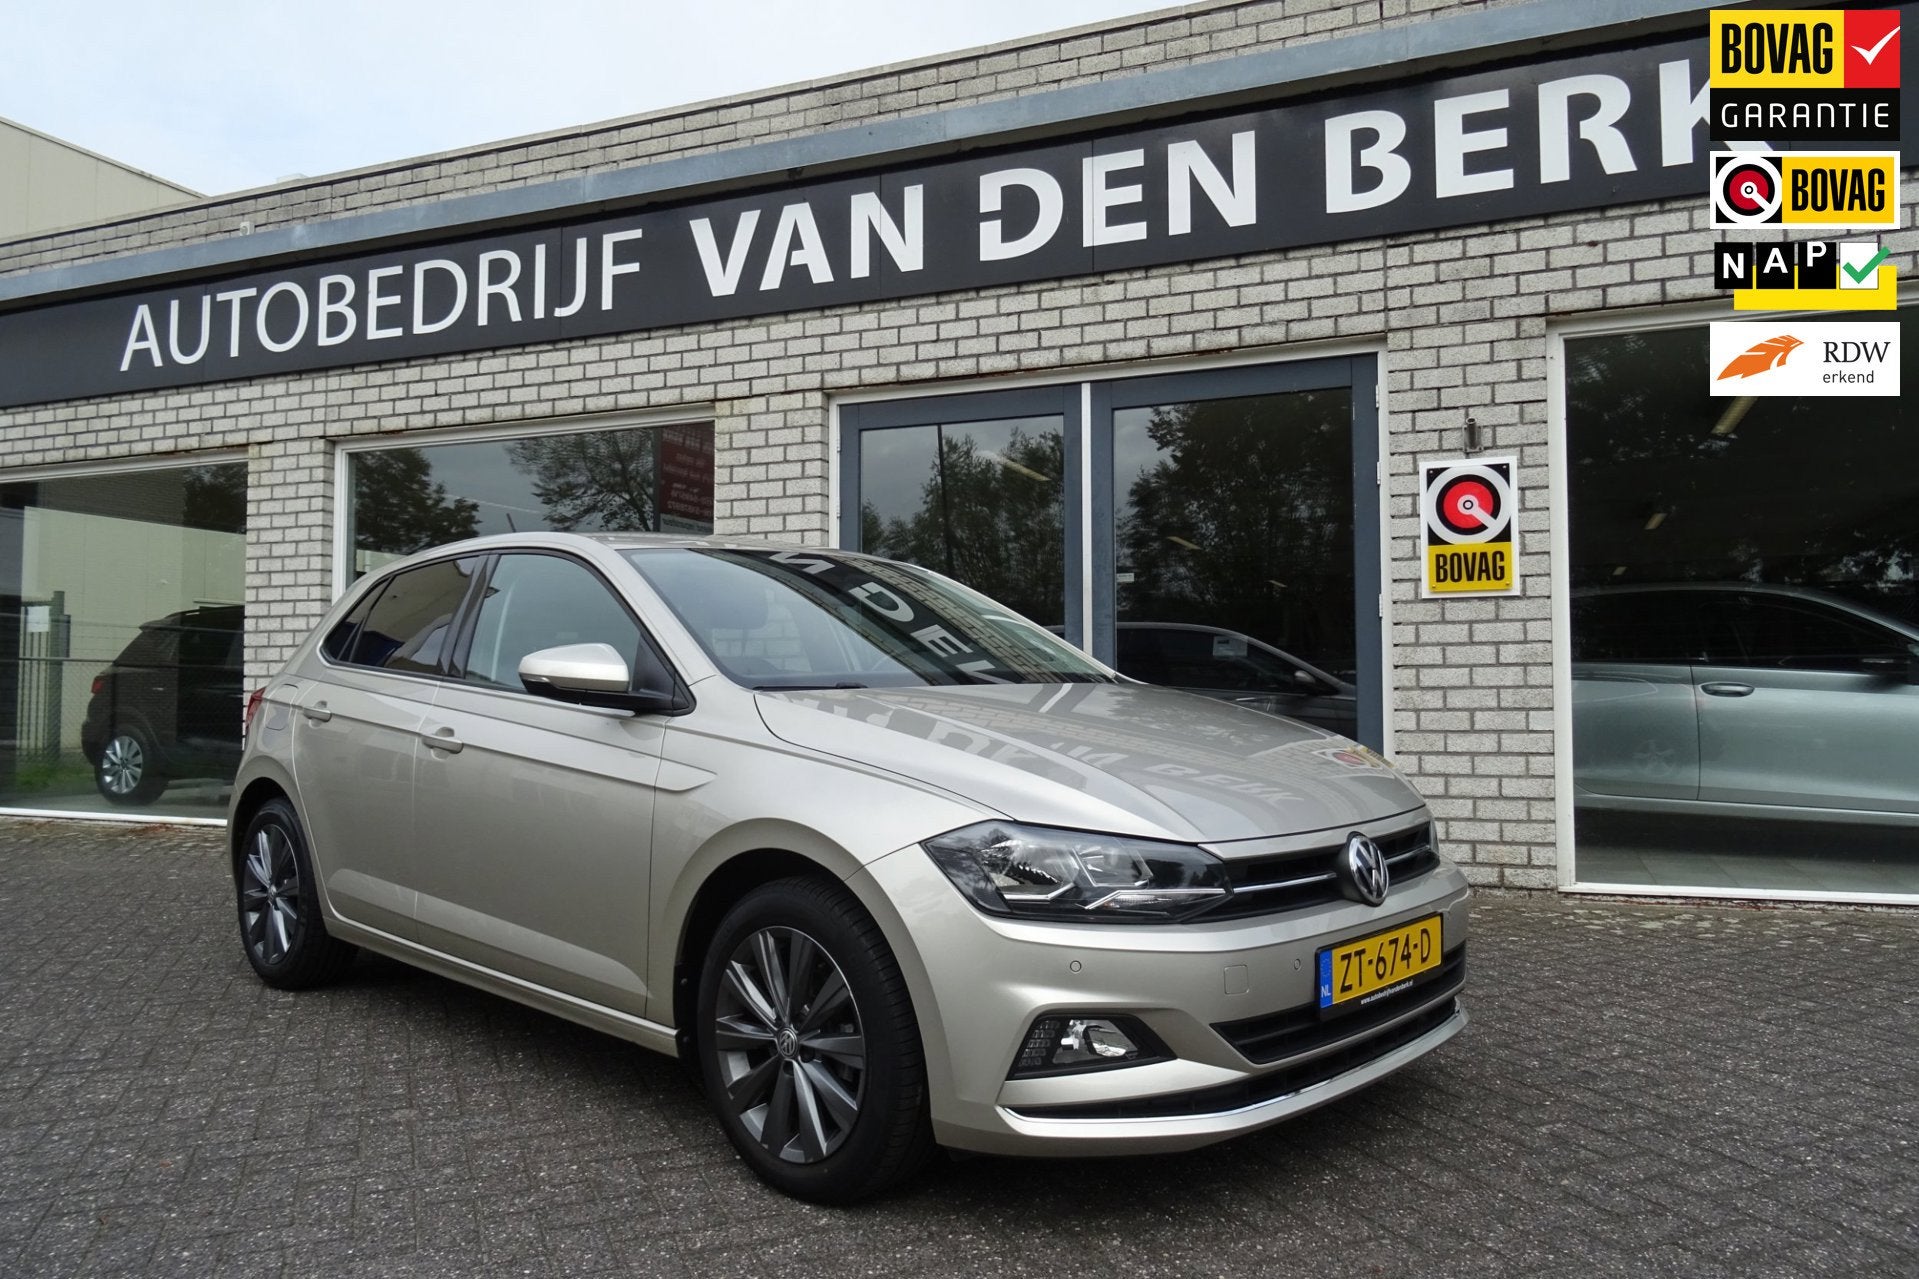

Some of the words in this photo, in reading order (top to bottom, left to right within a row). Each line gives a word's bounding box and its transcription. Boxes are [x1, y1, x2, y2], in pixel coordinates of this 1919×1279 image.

[120, 228, 643, 372] AUTOBEDRIJF
[689, 184, 924, 298] VAN
[979, 130, 1257, 262] DEN
[1434, 550, 1505, 583] BOVAG
[1320, 985, 1332, 998] NL
[1340, 927, 1431, 994] ZT-674-D
